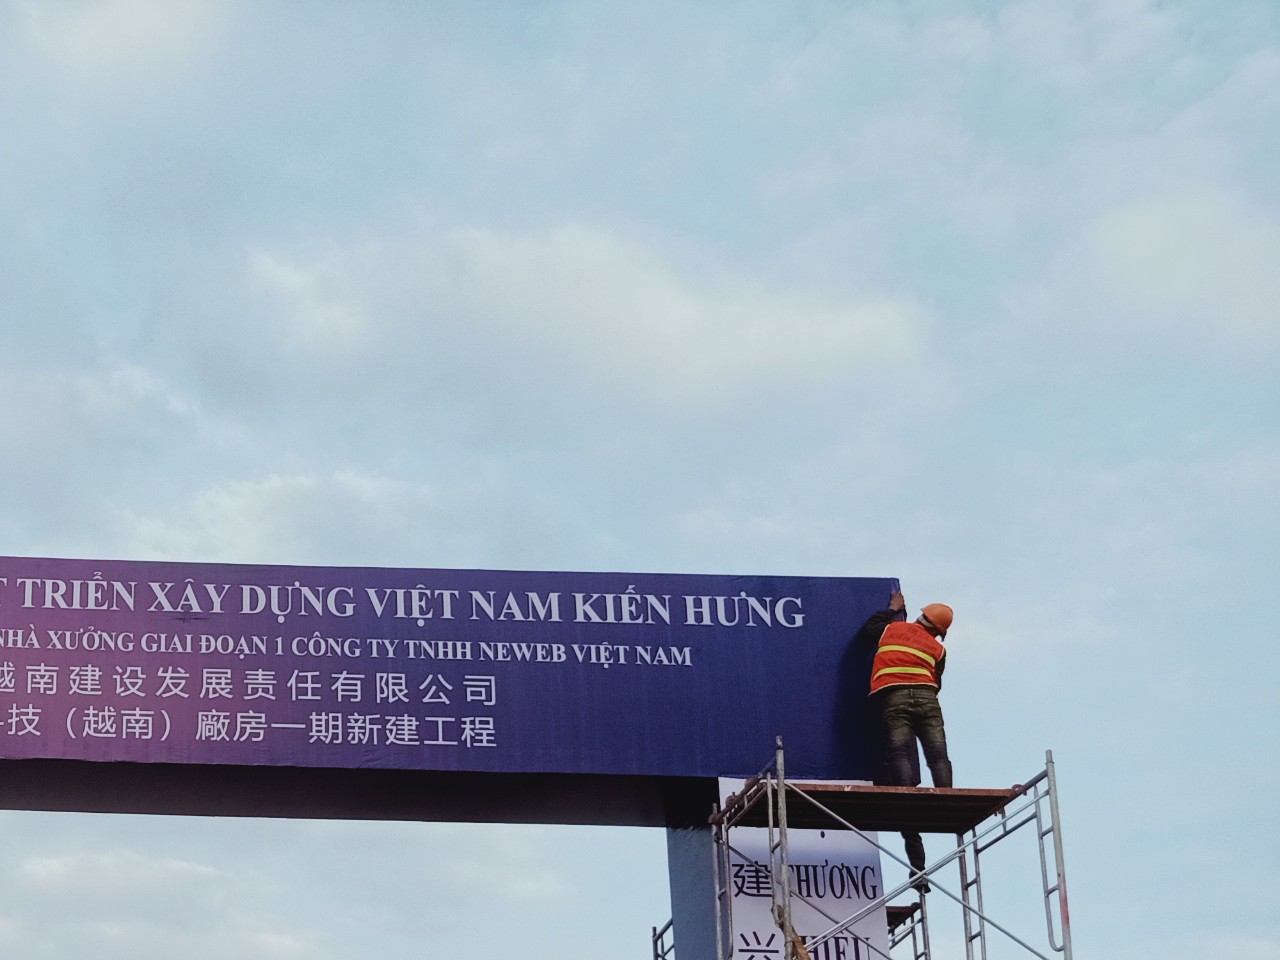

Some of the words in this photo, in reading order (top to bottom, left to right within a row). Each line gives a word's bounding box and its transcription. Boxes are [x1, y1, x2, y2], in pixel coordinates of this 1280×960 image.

[16, 571, 138, 612] TRIỂN
[147, 578, 231, 614] XÂY
[239, 581, 356, 624] DỰNG
[365, 584, 459, 627] VIỆT
[468, 590, 563, 623] NAM
[571, 585, 671, 625] KIẾN
[682, 591, 806, 628] HƯNG
[47, 626, 134, 652] XƯỞNG
[140, 633, 193, 653] GIAI
[199, 635, 268, 659] ĐOẠN
[274, 636, 284, 656] 1
[291, 631, 362, 657] CÔNG
[367, 639, 399, 659] TY
[403, 640, 473, 661] TNHH
[478, 642, 567, 663] NEWEB
[571, 642, 629, 668] VIỆT
[634, 646, 693, 666] NAM
